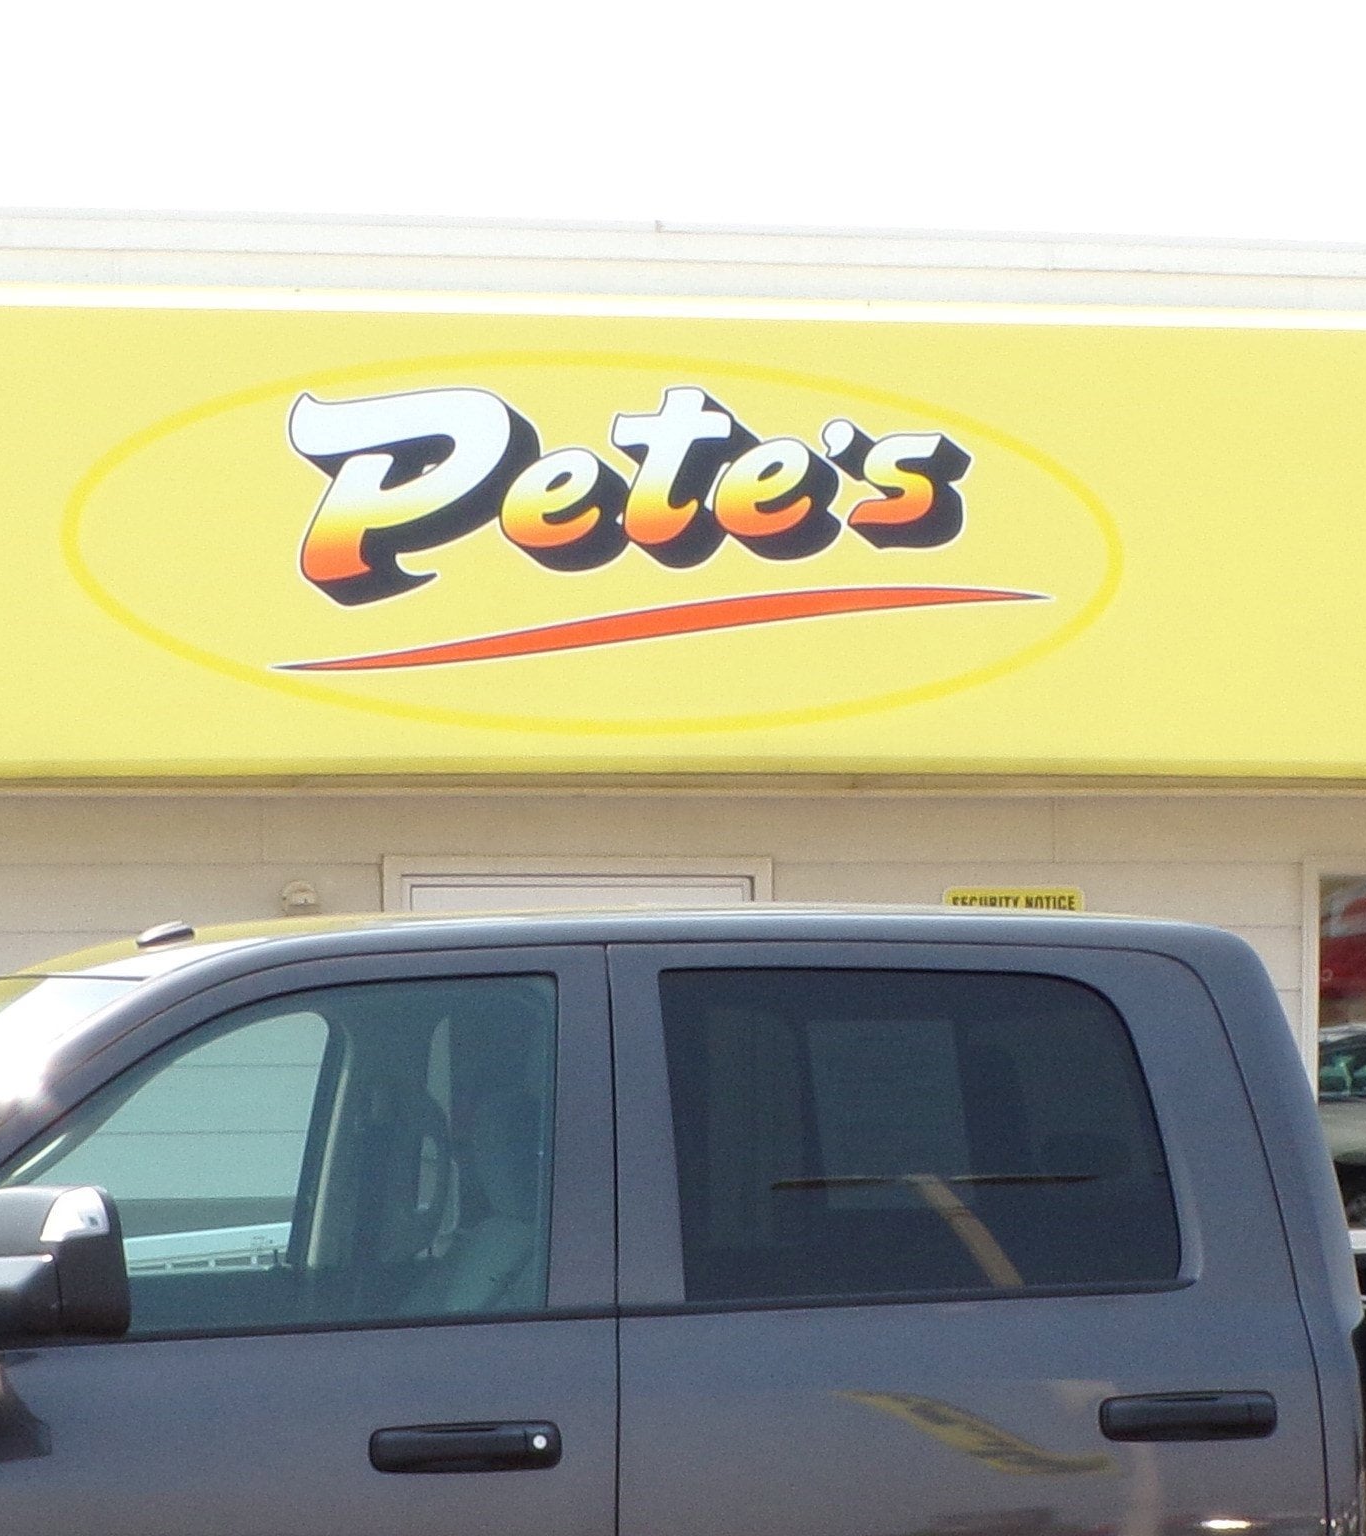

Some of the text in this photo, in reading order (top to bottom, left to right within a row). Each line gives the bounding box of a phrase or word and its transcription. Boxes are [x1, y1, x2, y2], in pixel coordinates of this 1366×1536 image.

[289, 386, 971, 606] Pete's
[951, 895, 1075, 910] SECURITY NOTICE
